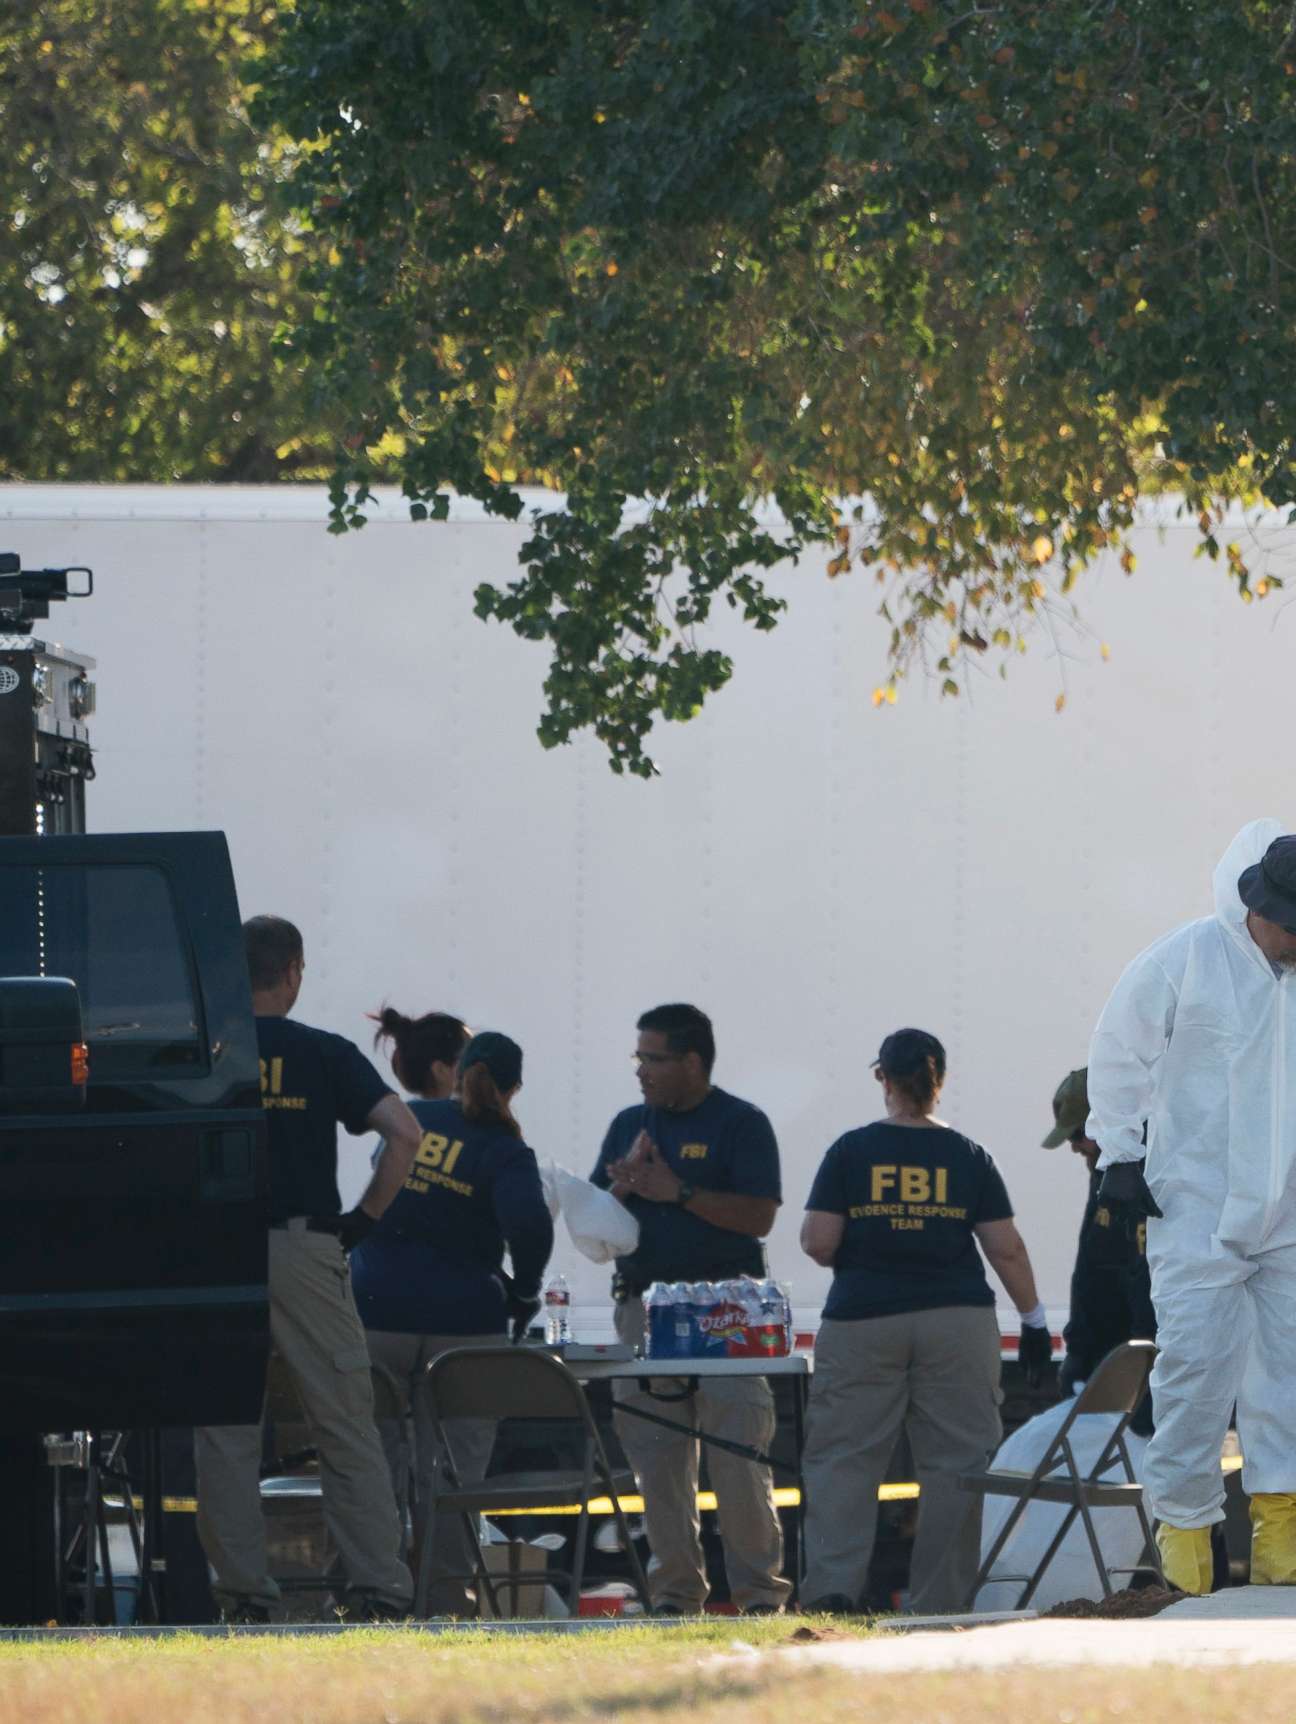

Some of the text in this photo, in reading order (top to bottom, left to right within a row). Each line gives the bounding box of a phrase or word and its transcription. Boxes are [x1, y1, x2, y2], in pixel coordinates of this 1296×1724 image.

[263, 1097, 306, 1110] SPONSE
[416, 1131, 463, 1173] BI
[681, 1143, 708, 1159] FBI
[404, 1179, 429, 1193] EAM
[871, 1165, 947, 1203] FBI
[849, 1204, 967, 1219] EVIDENCE RESPONSE
[891, 1218, 924, 1231] TEAM
